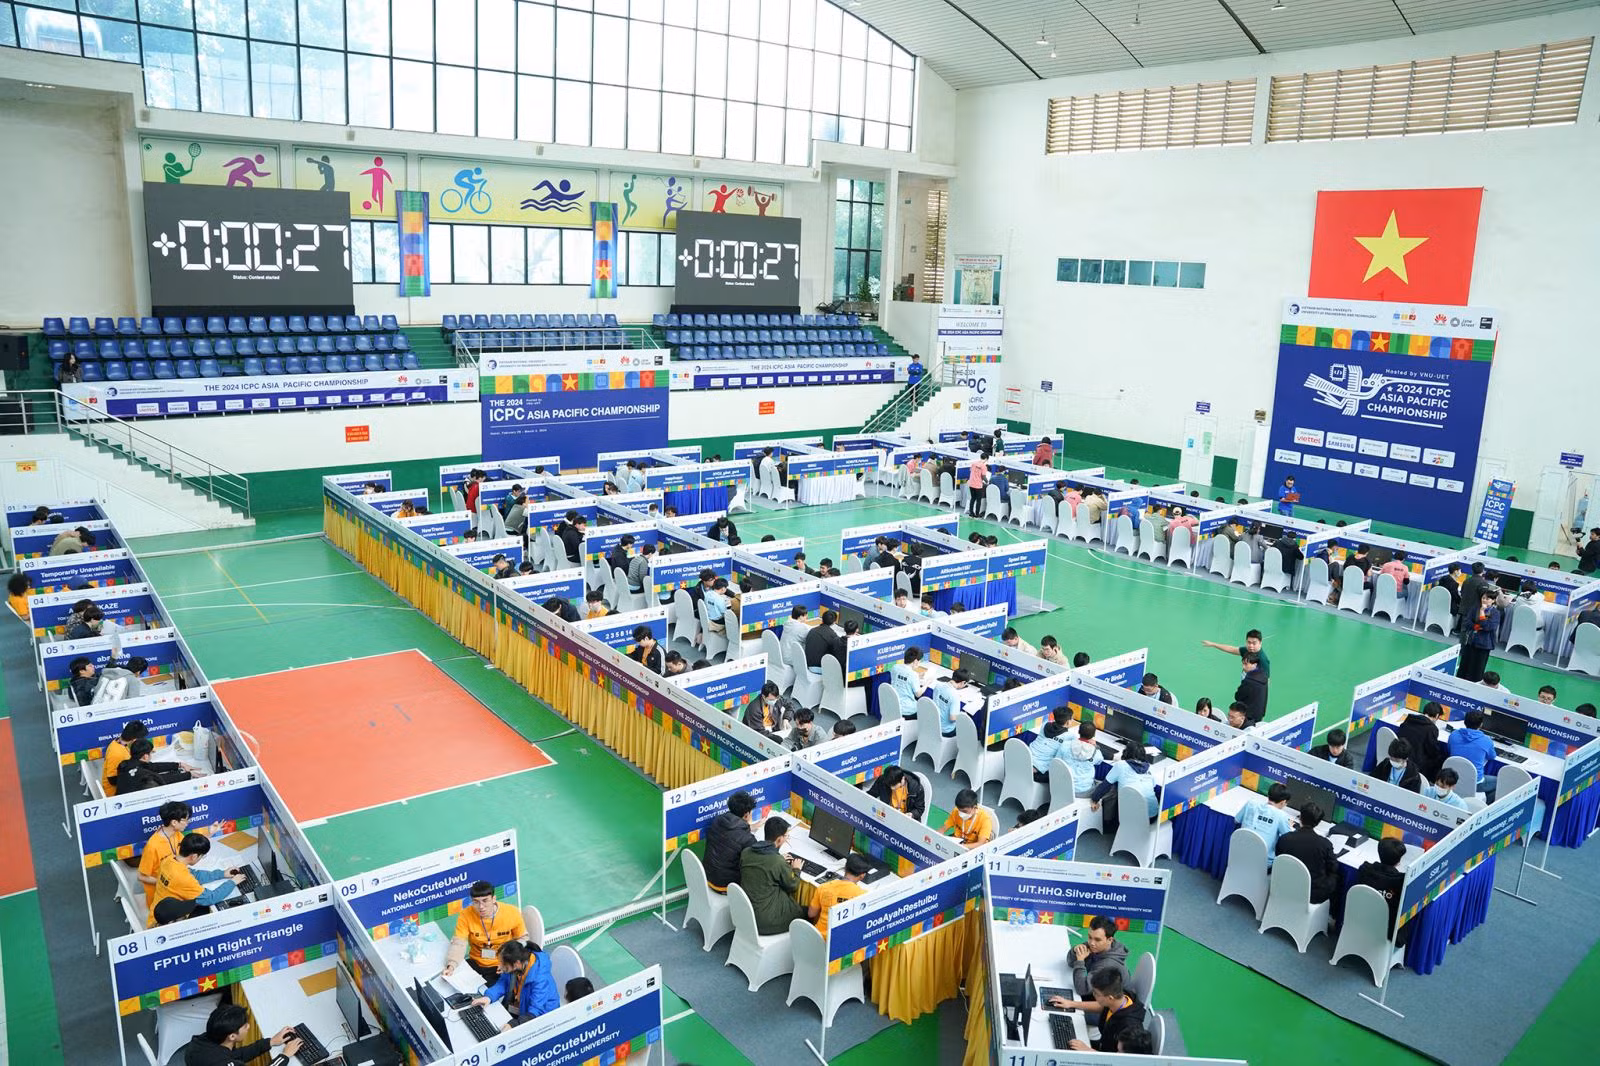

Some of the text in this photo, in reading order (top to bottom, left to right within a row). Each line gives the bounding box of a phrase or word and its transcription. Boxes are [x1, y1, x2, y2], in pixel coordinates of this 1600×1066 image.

[152, 219, 350, 272] +0:00:27
[678, 238, 799, 280] +0:00:27
[1386, 368, 1408, 376] Hosted
[1420, 372, 1450, 380] VNU-UET
[204, 384, 220, 392] THE
[283, 380, 312, 388] PACIFIC
[314, 378, 369, 388] CHAMPIONSHIP
[1397, 384, 1451, 398] 2024 ICPC
[1380, 393, 1448, 408] ASIA PACIFIC
[490, 408, 525, 421] ICPC
[552, 408, 588, 418] PACIFIC
[591, 404, 660, 416] CHAMPIONSHIP
[1367, 402, 1448, 421] CHAMPIONSHIP
[1485, 500, 1505, 510] ICPC
[41, 564, 115, 578] Temporarily Unavailable
[992, 662, 1010, 673] PACIFIC
[609, 667, 622, 681] PACIFIC
[622, 676, 650, 696] CHAMPIONSHIP
[1088, 698, 1099, 707] THE
[1429, 690, 1475, 710] THE 2024 ICPC
[59, 715, 74, 723] 06
[676, 710, 685, 718] THE
[685, 714, 696, 725] 2024
[695, 720, 706, 732] ICPC
[706, 727, 717, 739] ASIA
[717, 734, 735, 750] PACIFIC
[1145, 720, 1168, 735] PACIFIC
[1527, 721, 1580, 742] HAMPIONSHIP
[1268, 766, 1283, 776] THE
[670, 794, 681, 804] 12
[83, 806, 99, 818] 07
[809, 789, 820, 799] THE
[820, 795, 834, 808] 2024
[835, 804, 849, 817] ICPC
[850, 812, 864, 827] ASIA
[865, 822, 890, 842] PACIFIC
[1341, 793, 1438, 835] PACIFIC CHAMPIONSHIP
[974, 852, 984, 864] 13
[988, 862, 1001, 871] 11
[341, 883, 357, 896] 09
[393, 872, 468, 903] NekoCuteUwU
[1018, 884, 1127, 902] UIT.HHQ.SilverBullet
[381, 893, 444, 917] NATIONAL CENTRAL
[836, 909, 849, 921] 12
[118, 942, 138, 956] 08
[154, 952, 191, 971] FPTU
[194, 945, 214, 960] HN
[218, 937, 252, 954] Right
[254, 922, 304, 943] Triangle
[202, 946, 263, 968] FPT UNIVERSITY
[580, 1030, 620, 1053] UNIVERSITY
